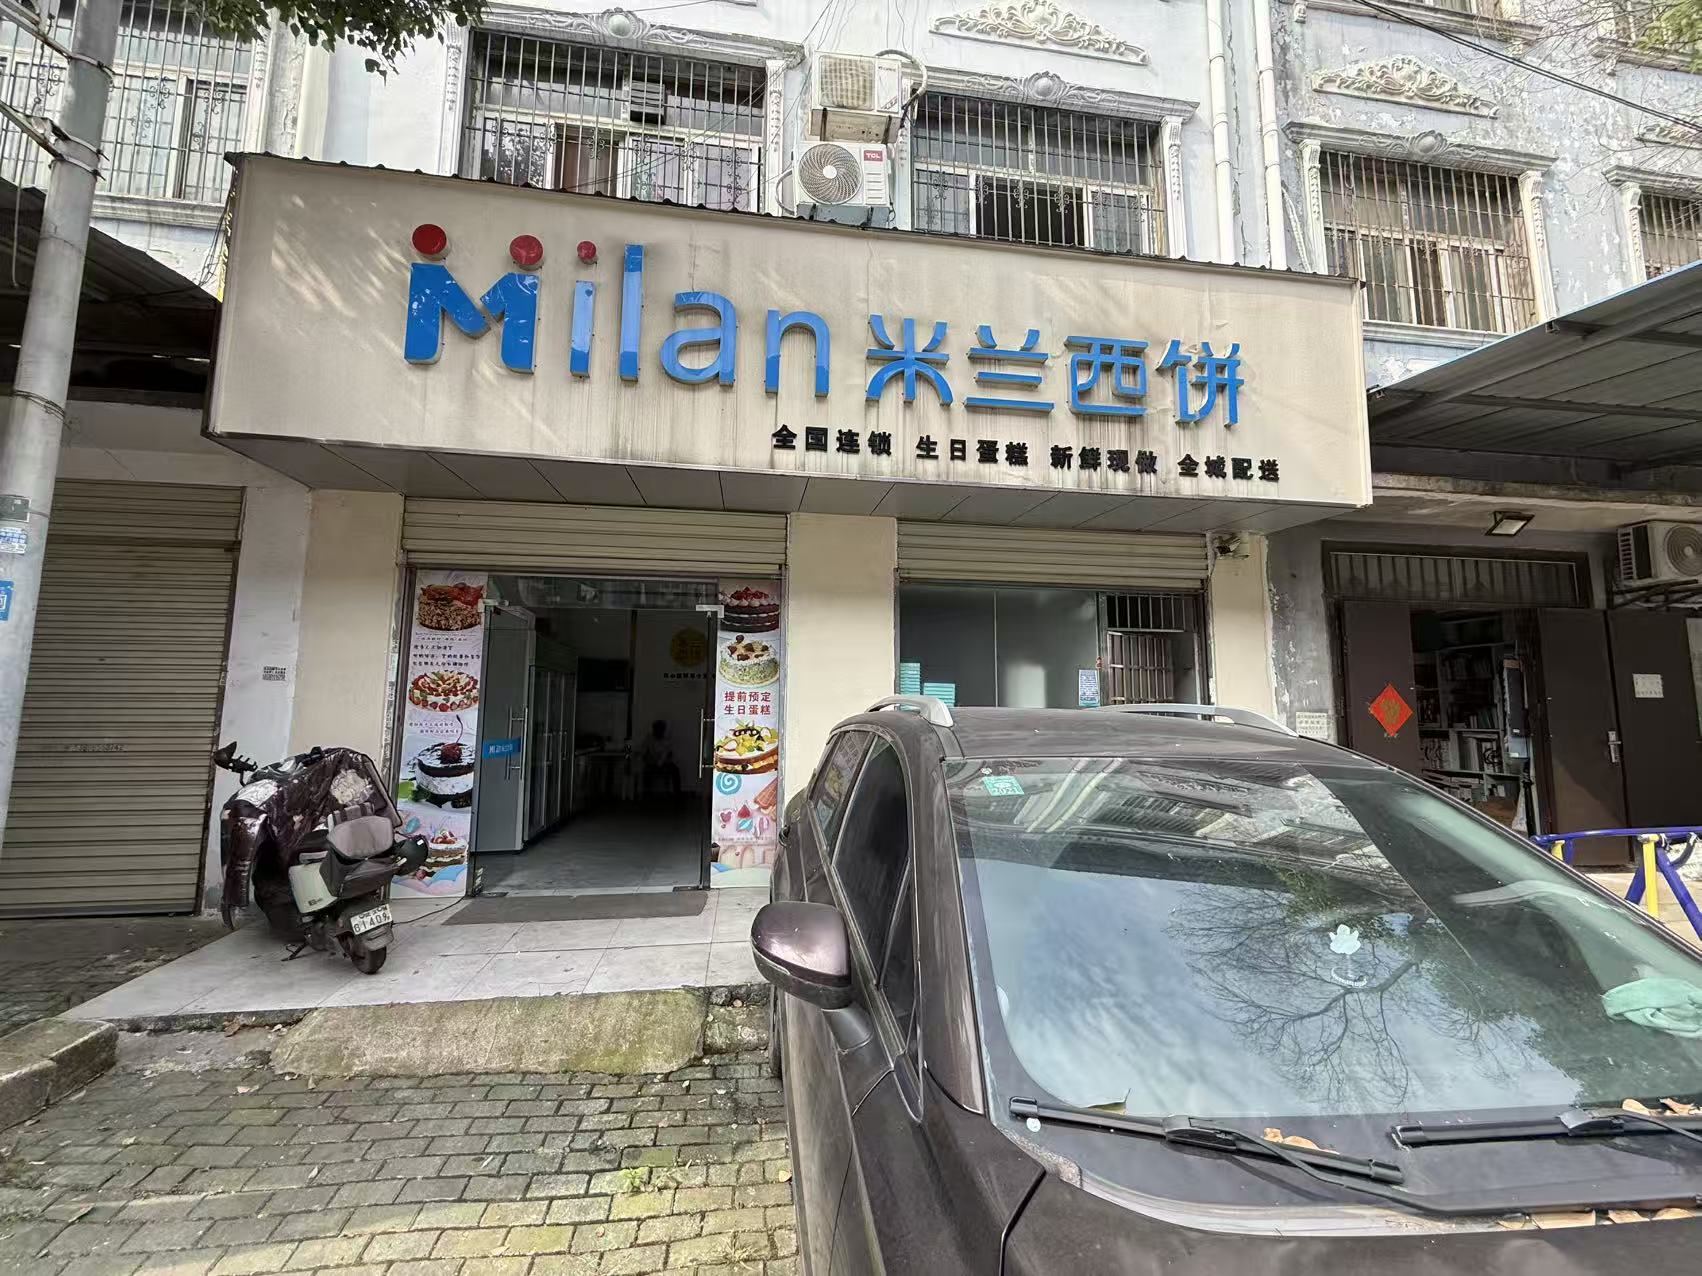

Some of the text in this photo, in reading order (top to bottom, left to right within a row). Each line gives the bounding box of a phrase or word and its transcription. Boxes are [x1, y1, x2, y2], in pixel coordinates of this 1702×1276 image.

[404, 223, 831, 398] Milan
[865, 313, 1245, 428] 米兰西饼
[772, 424, 1280, 482] 全国连锁 生日蛋糕 新鲜现做 全城配送
[724, 691, 771, 703] 提前预定
[724, 704, 771, 715] 生日蛋糕
